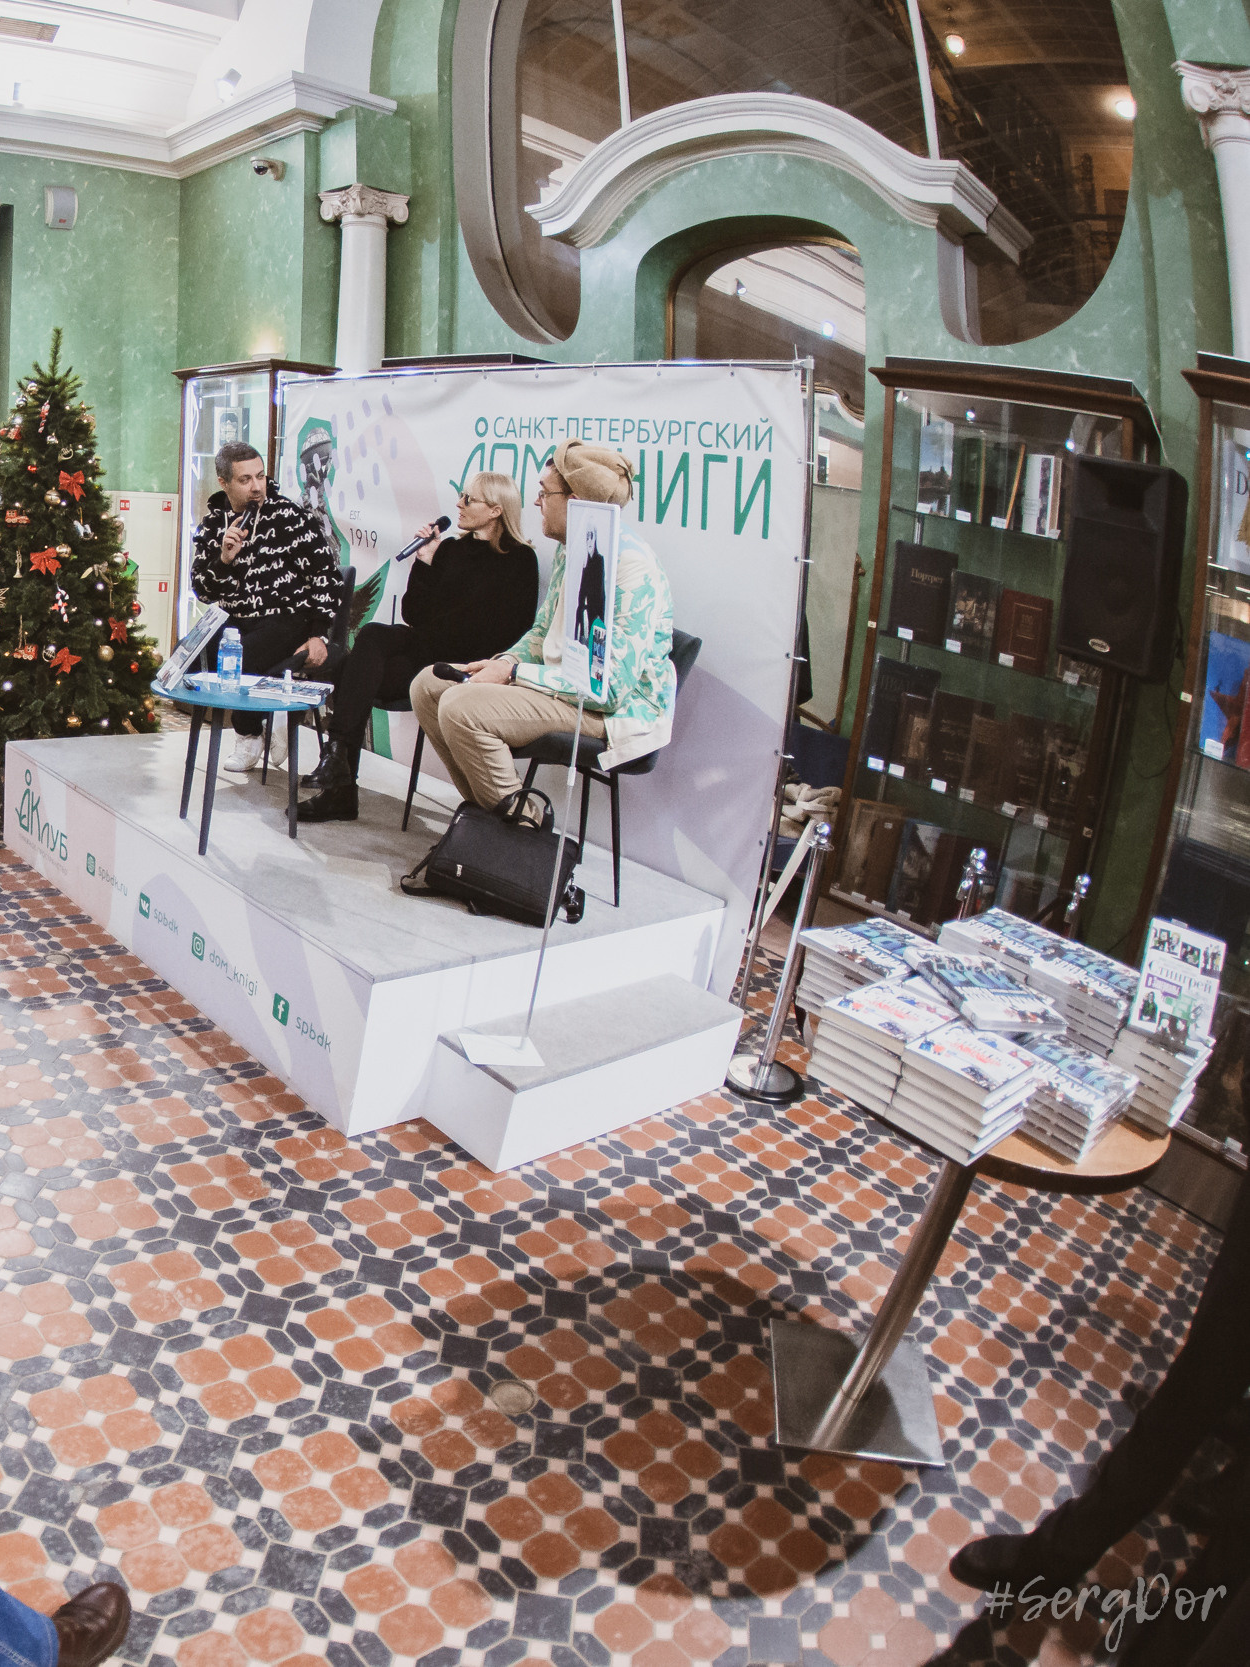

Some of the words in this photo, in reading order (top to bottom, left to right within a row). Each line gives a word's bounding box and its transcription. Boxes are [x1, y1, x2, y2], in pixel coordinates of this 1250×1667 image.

[493, 416, 773, 453] САНКТ-ПЕТЕРБУРГСКИЙ
[616, 447, 772, 540] НИГИ
[350, 528, 377, 549] 1919
[153, 908, 179, 935] spbdk
[209, 950, 258, 996] dom_knigi
[295, 1016, 331, 1053] spbdk
